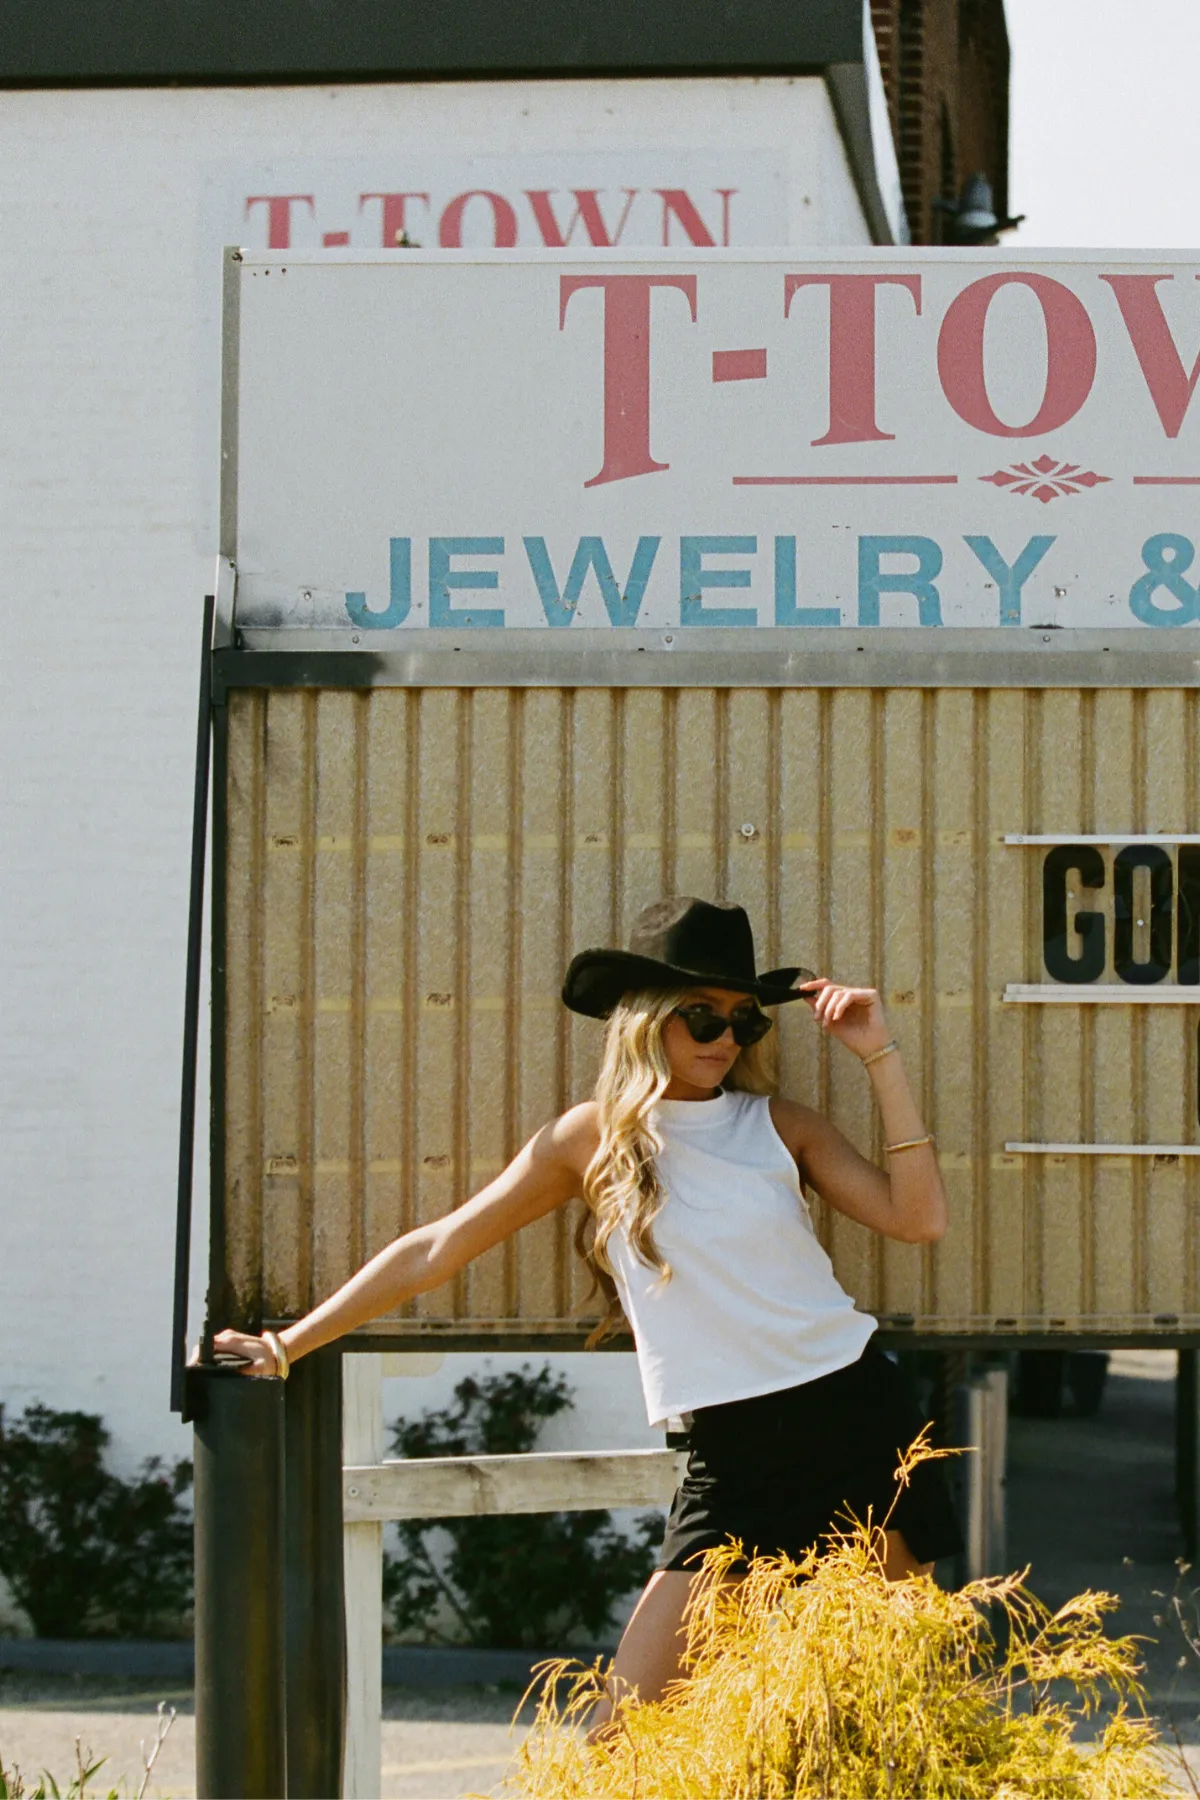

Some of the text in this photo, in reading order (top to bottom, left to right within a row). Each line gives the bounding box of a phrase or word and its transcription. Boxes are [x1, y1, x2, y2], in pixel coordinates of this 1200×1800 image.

[245, 188, 741, 248] T-TOWN
[344, 532, 1200, 630] JEWELRY &
